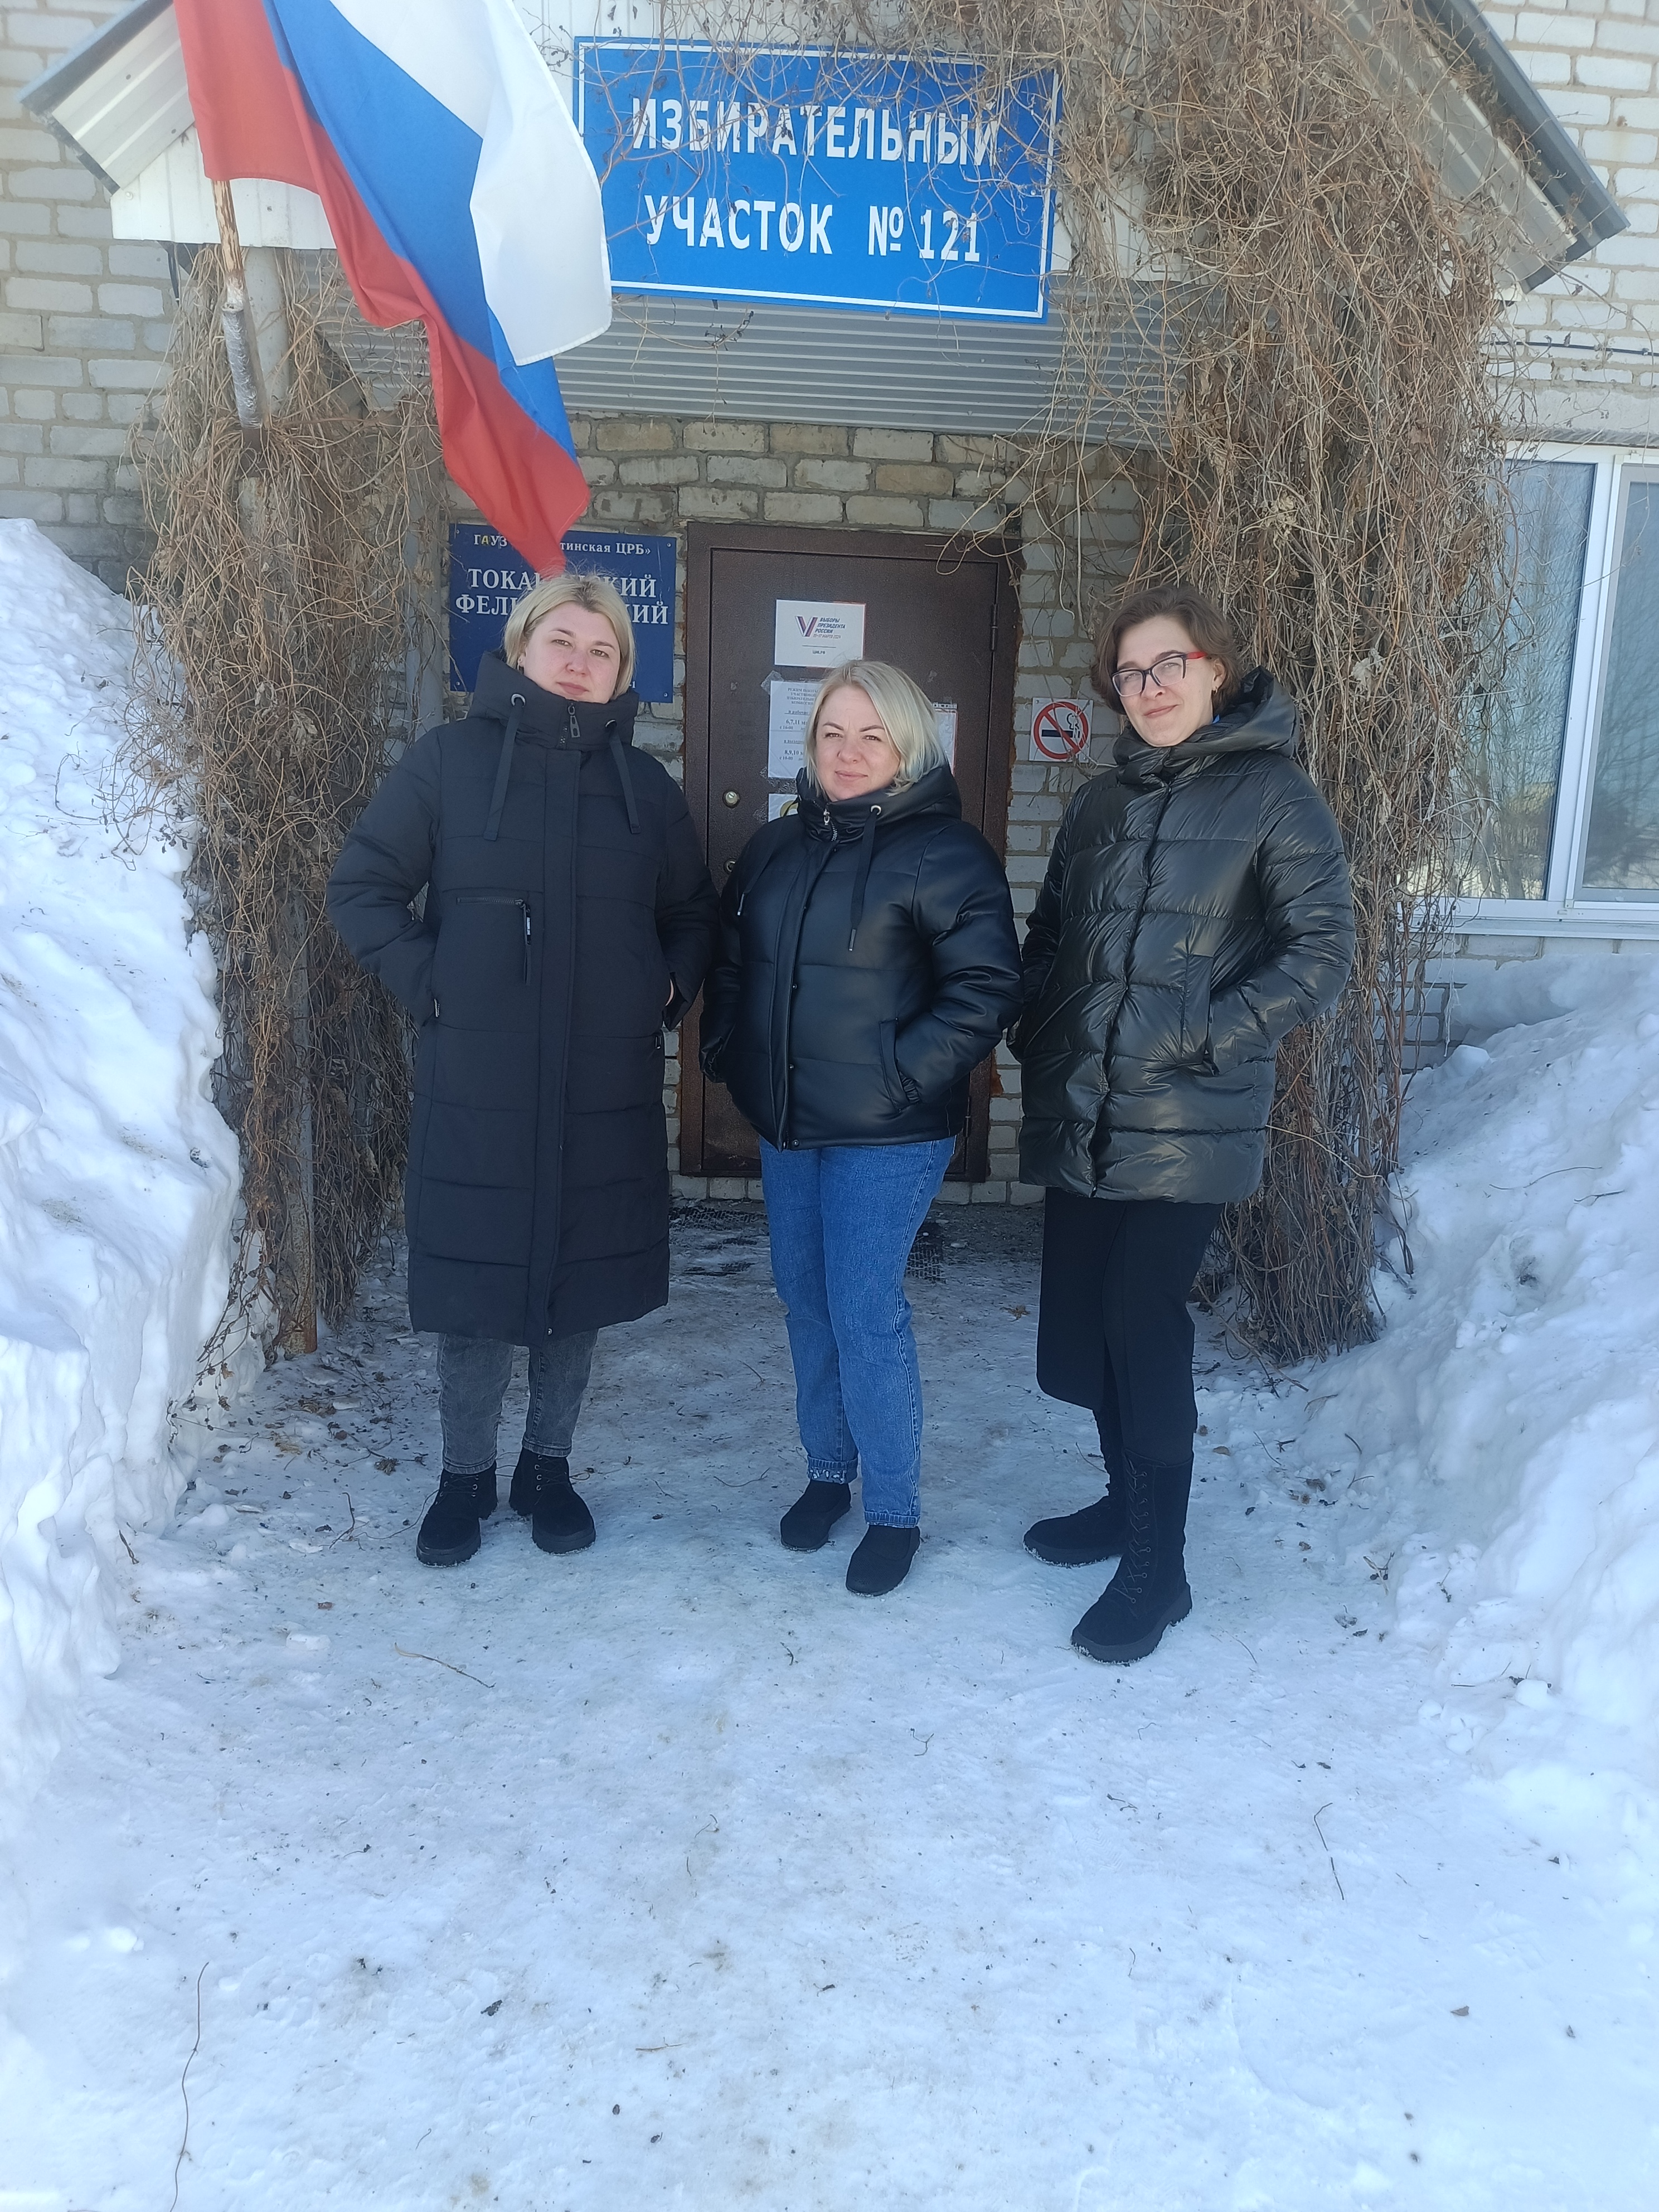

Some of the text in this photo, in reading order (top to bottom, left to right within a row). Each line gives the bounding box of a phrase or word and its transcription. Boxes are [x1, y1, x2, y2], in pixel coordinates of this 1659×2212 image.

[633, 98, 997, 166] ИЗБИРАТЕЛЬНЫЙ
[644, 195, 979, 262] УЧАСТОК № 121
[474, 533, 508, 547] ГАУЗ
[616, 543, 651, 555] ЦРБ»
